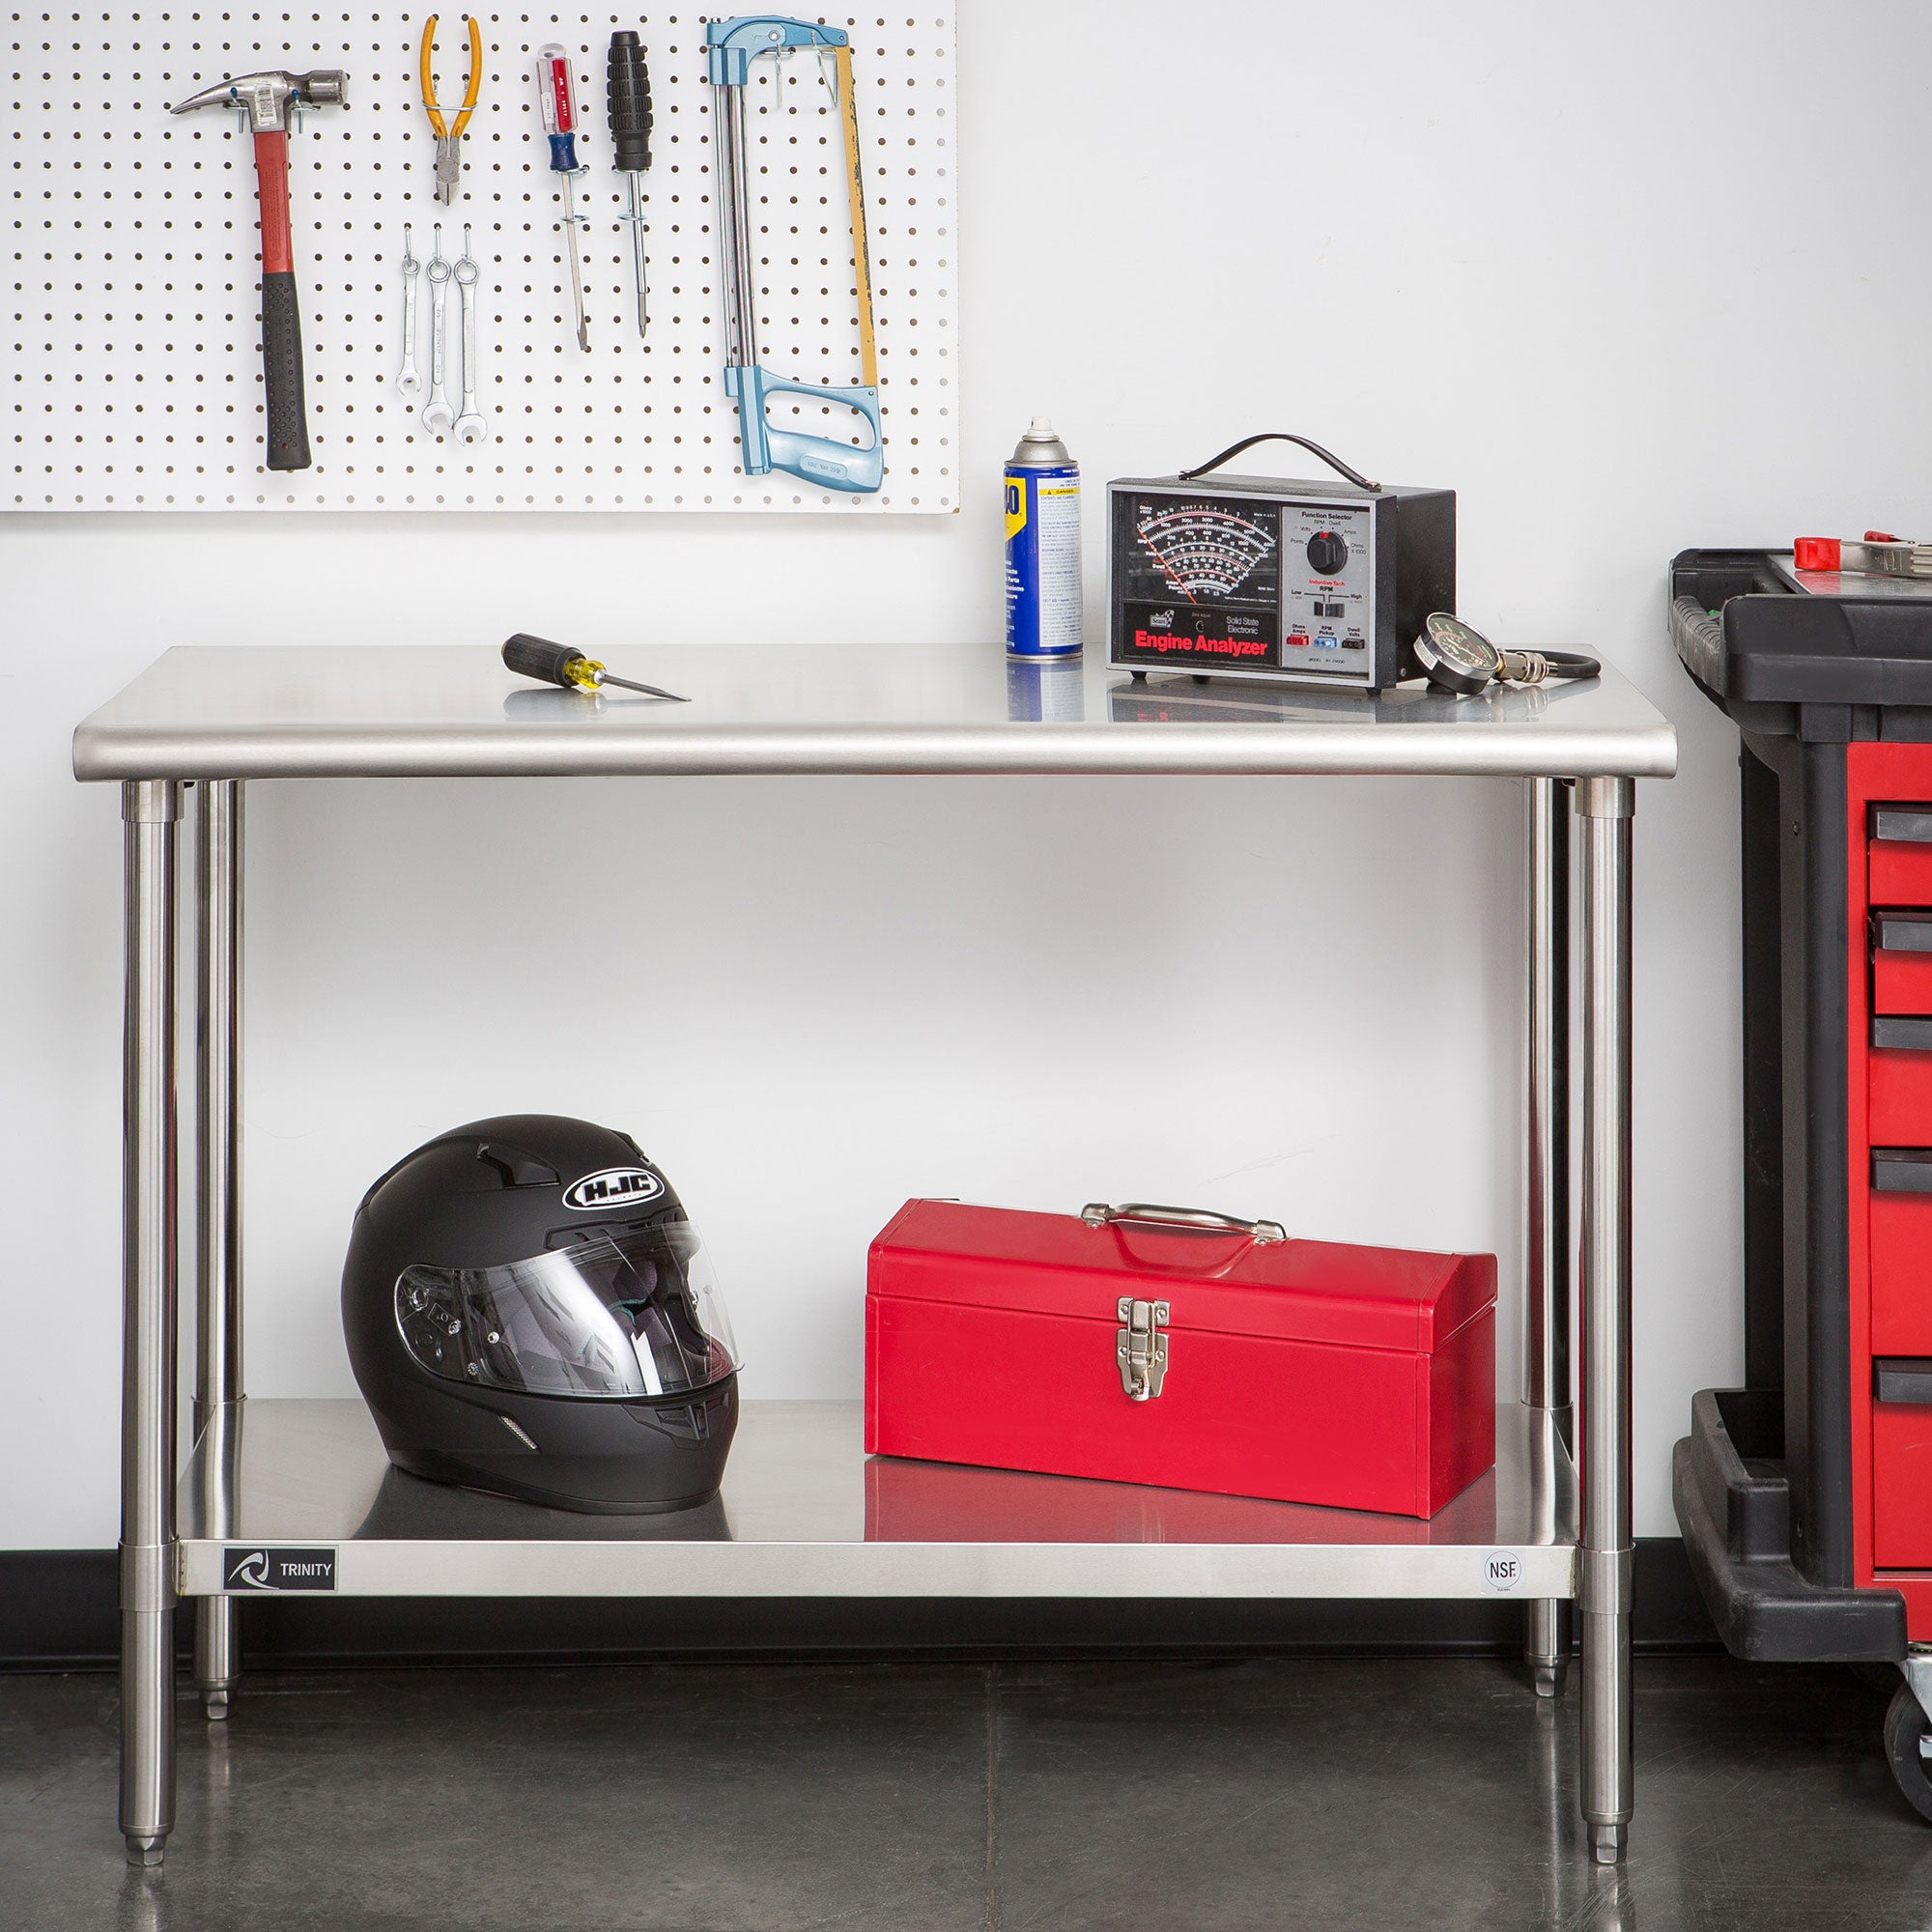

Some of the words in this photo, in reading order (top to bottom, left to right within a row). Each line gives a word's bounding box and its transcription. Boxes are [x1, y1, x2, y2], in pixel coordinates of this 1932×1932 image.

[1301, 511, 1327, 520] Function
[1226, 615, 1242, 625] Solid
[1242, 616, 1260, 627] State
[1227, 624, 1259, 635] Electronic
[1134, 630, 1193, 653] Engine
[1194, 634, 1268, 658] Analyzer
[583, 1174, 652, 1203] HJC
[279, 1563, 332, 1577] TRINITY
[1490, 1561, 1517, 1578] NSF
